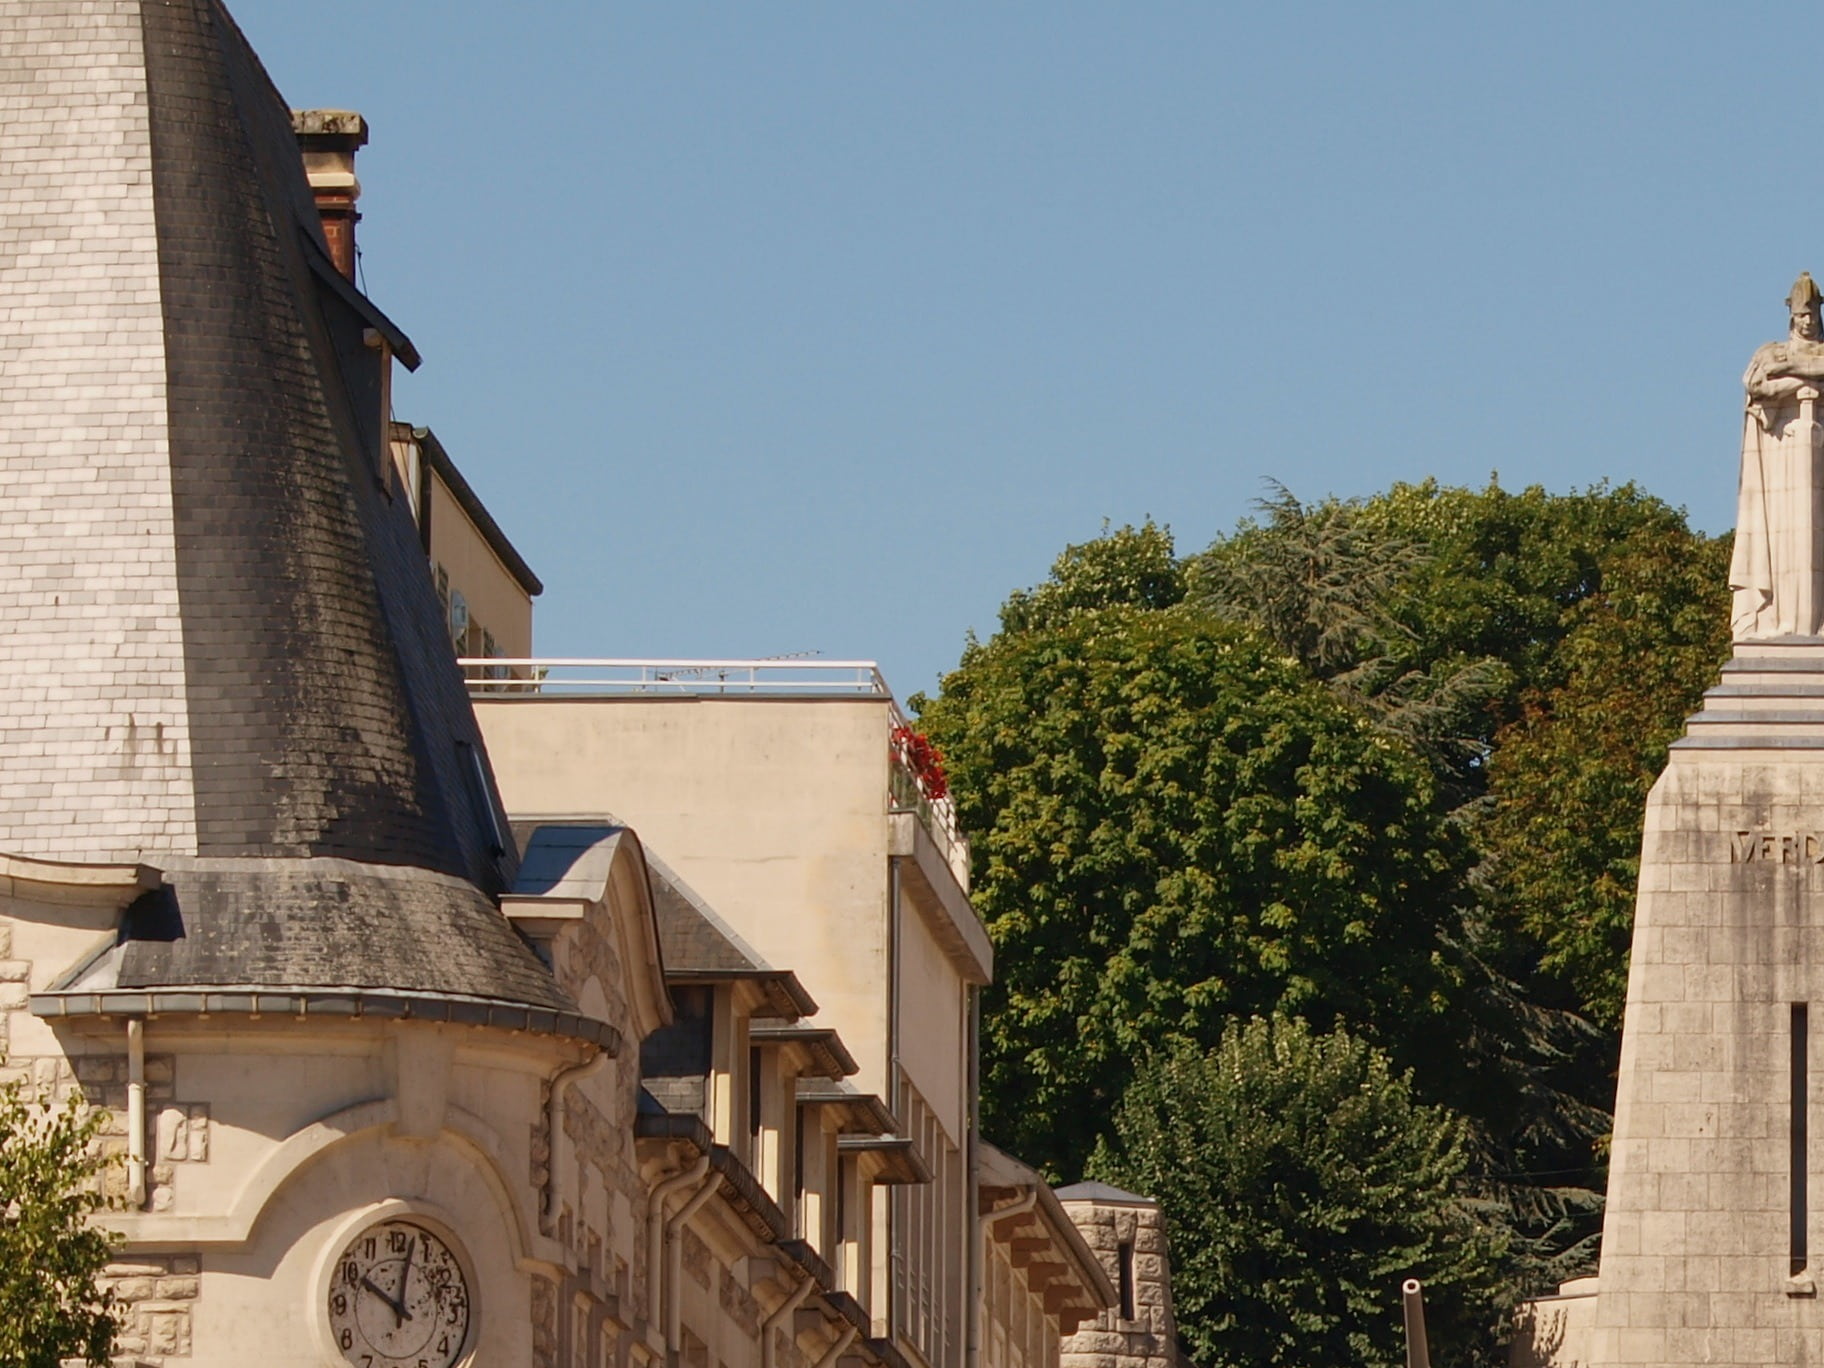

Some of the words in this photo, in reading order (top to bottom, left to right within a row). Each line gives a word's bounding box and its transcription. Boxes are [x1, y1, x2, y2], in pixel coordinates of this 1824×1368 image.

[363, 1237, 377, 1260] 11
[390, 1230, 406, 1253] 12
[341, 1260, 358, 1284] 10
[334, 1294, 347, 1316] 9
[341, 1328, 353, 1351] 8
[437, 1335, 450, 1358] 4
